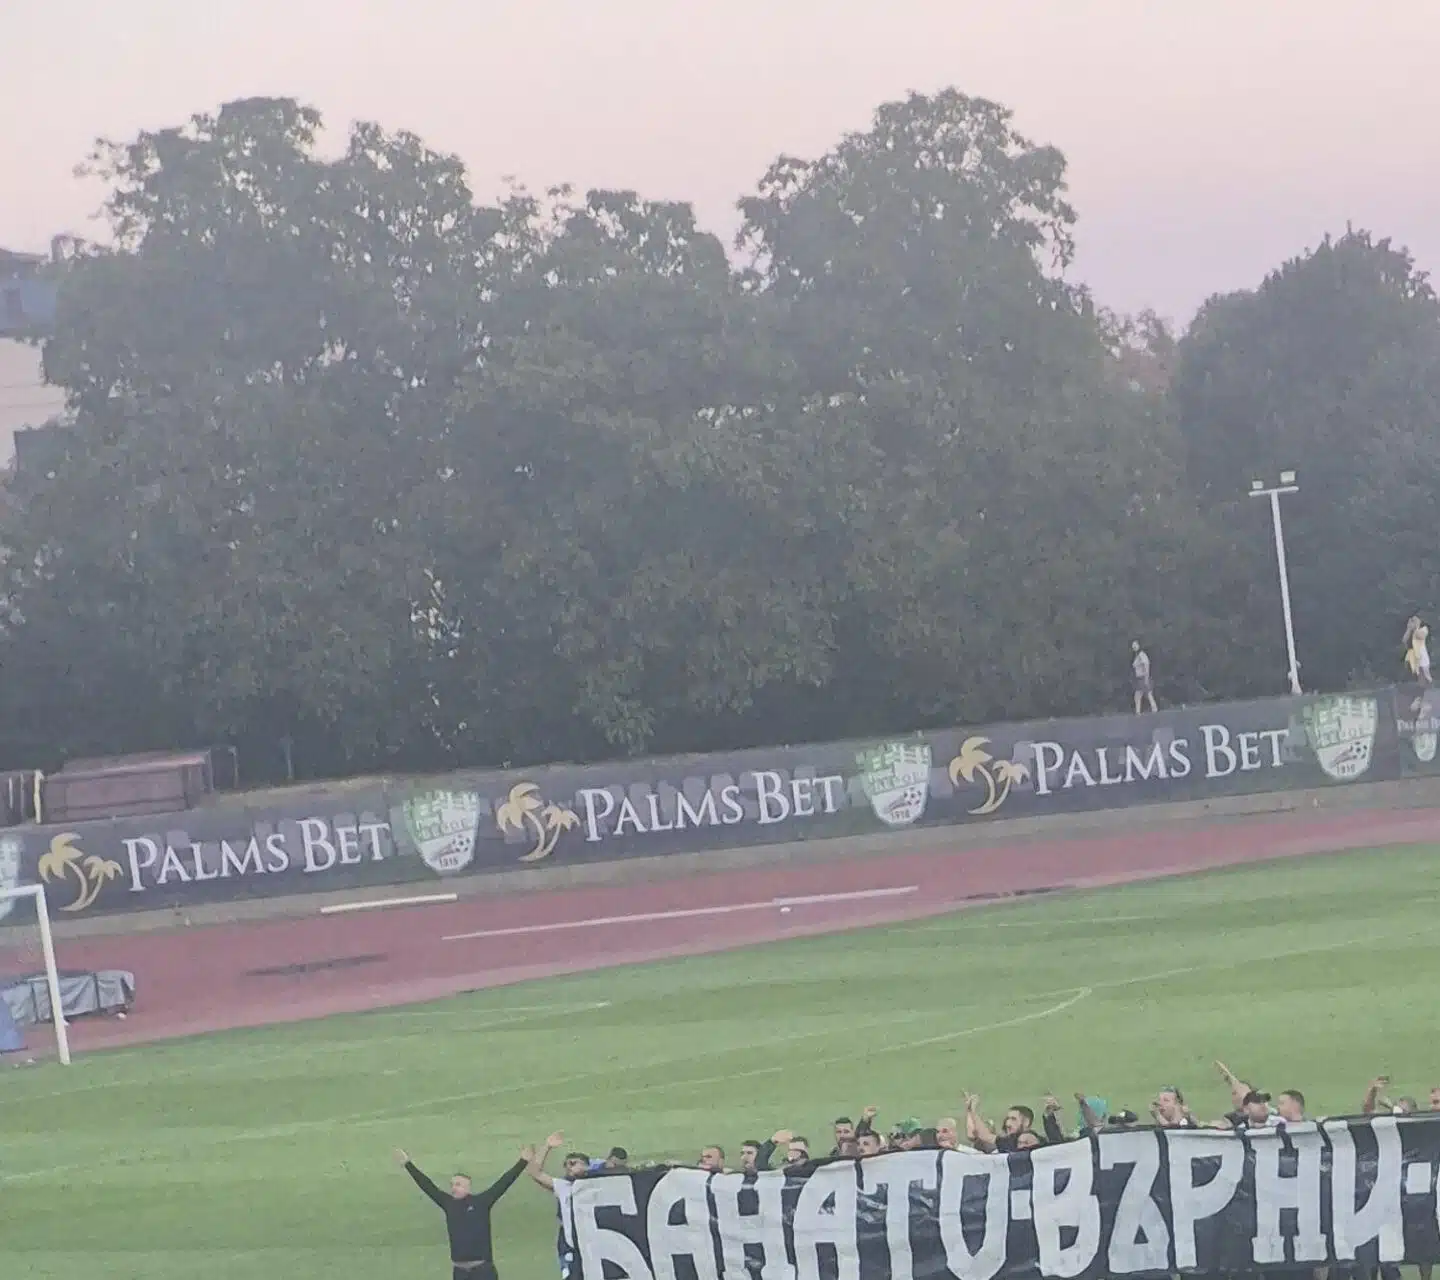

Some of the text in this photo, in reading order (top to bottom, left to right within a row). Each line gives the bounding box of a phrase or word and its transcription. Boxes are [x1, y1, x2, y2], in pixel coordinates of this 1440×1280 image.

[1030, 725, 1290, 795] PALMS BET
[579, 770, 843, 842] PALMS BET
[121, 819, 391, 892] PALMS BET
